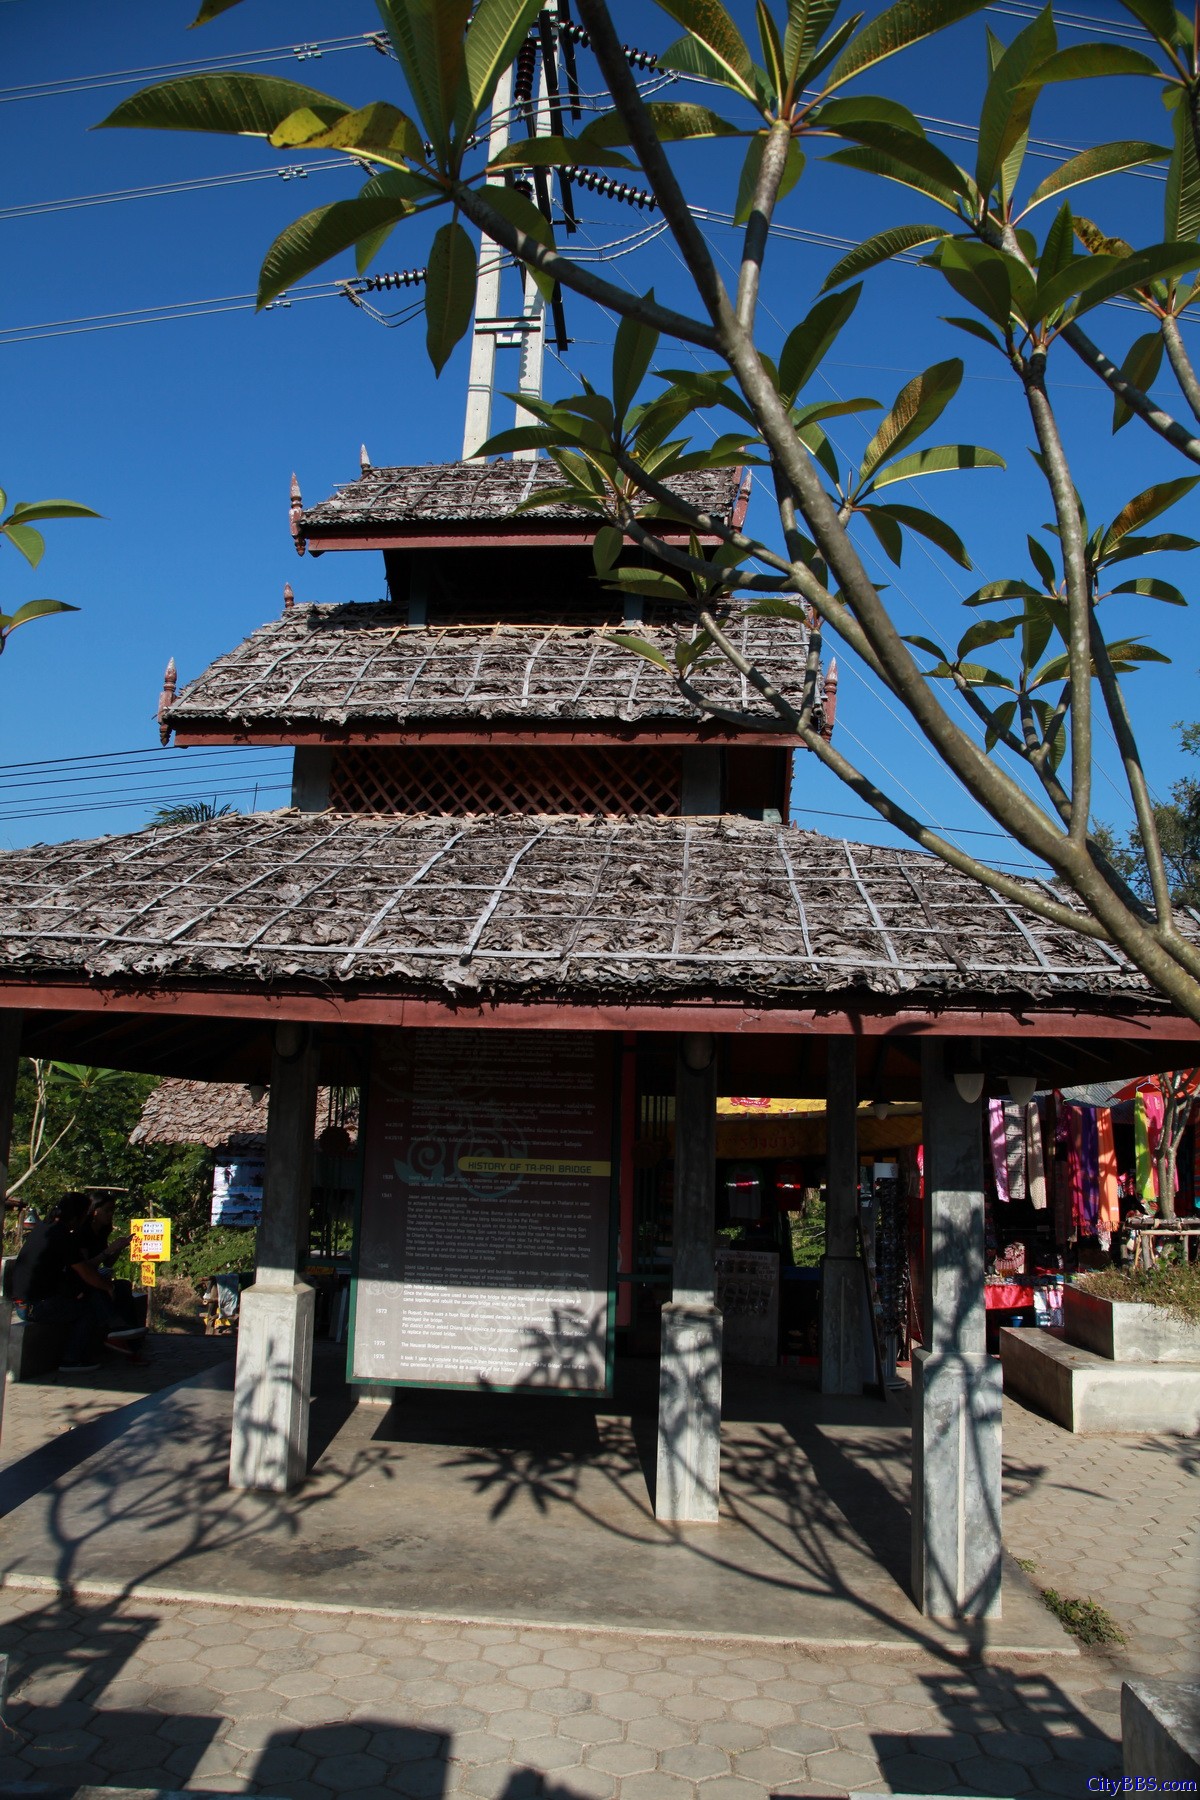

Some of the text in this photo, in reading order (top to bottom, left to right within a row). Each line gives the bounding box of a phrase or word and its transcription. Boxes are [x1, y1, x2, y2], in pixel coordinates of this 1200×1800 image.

[468, 1161, 592, 1174] HISTORY OF TA-PAI BRIDGE
